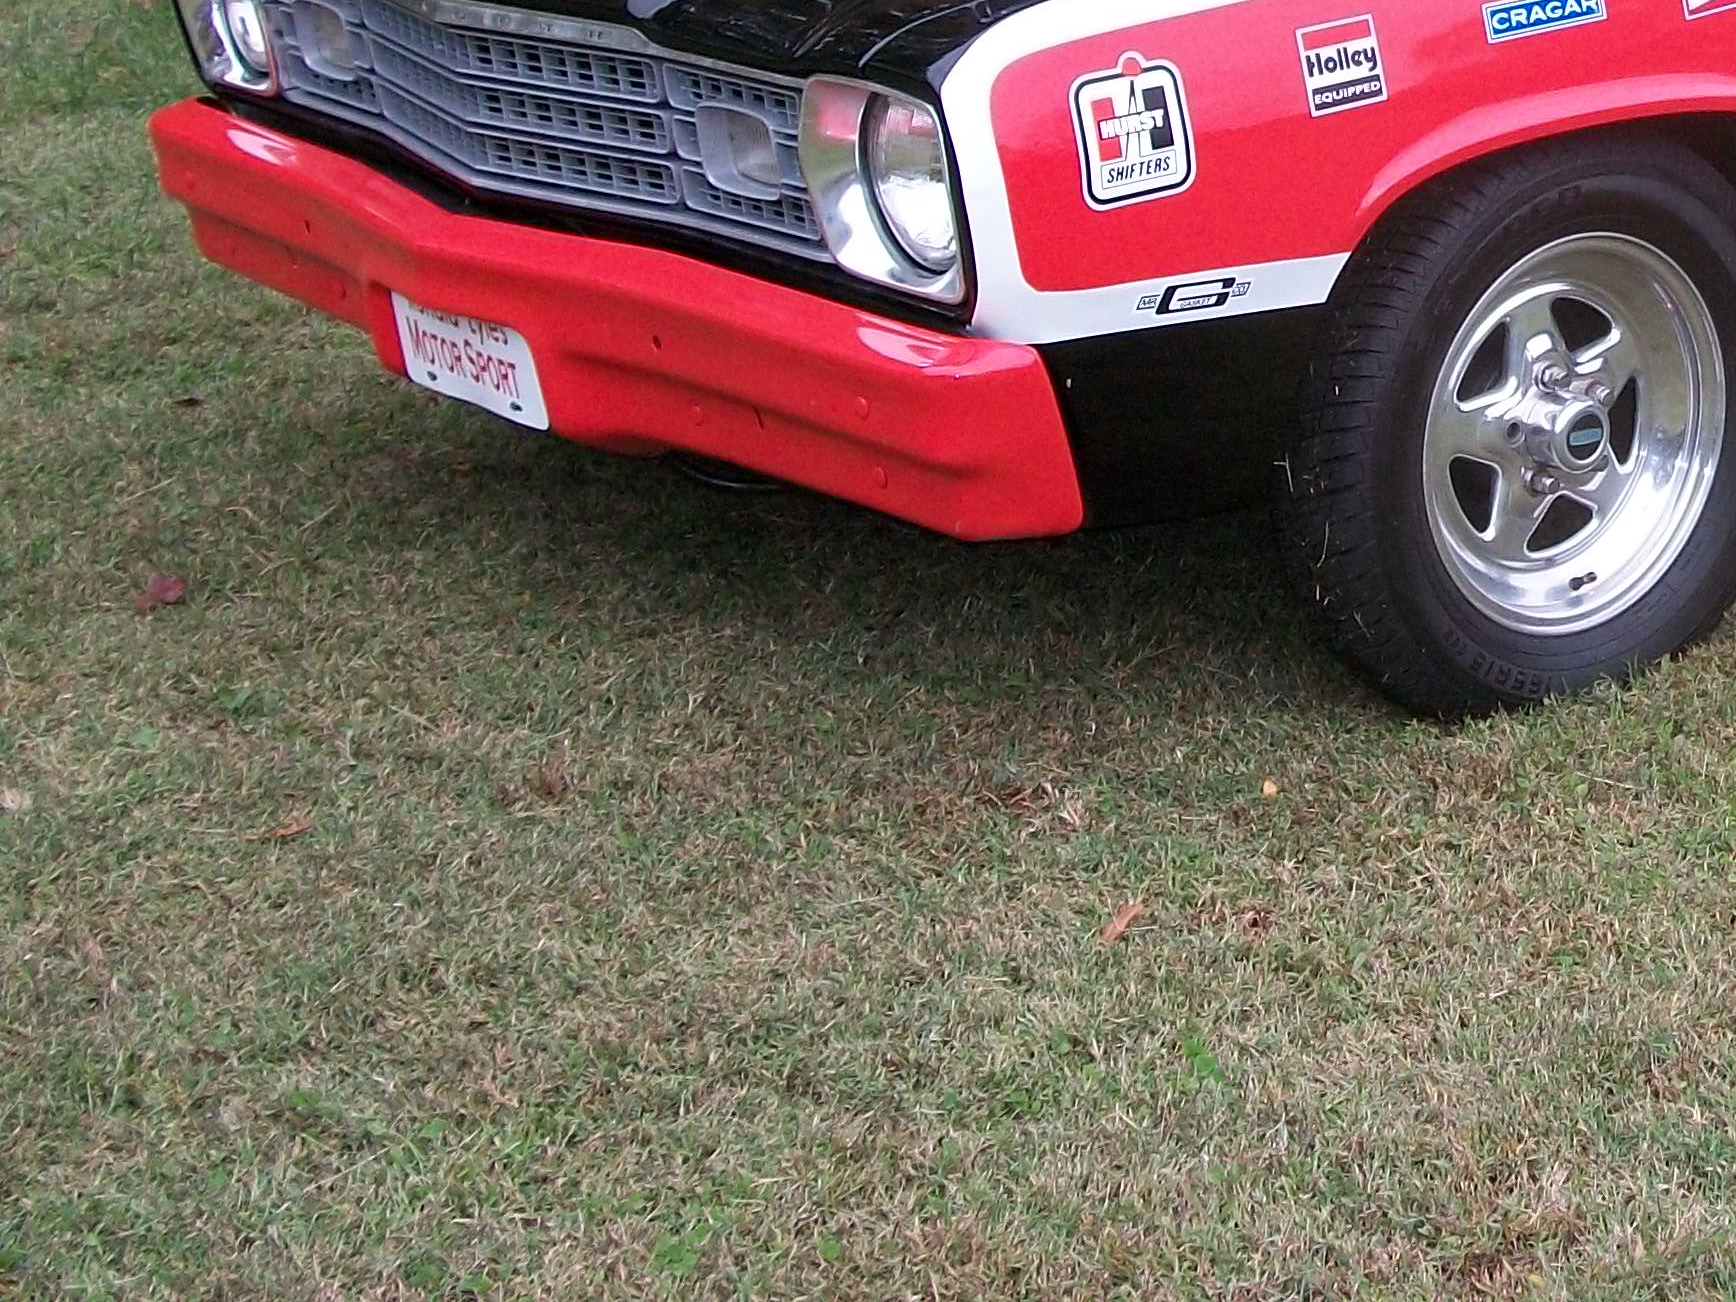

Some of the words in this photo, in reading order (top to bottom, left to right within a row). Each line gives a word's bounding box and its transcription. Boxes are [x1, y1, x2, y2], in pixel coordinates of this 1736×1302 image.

[1305, 46, 1378, 78] Holley
[1314, 81, 1380, 104] EQUIPPED
[1098, 108, 1164, 140] HURST
[1107, 156, 1171, 183] SHIFTERS
